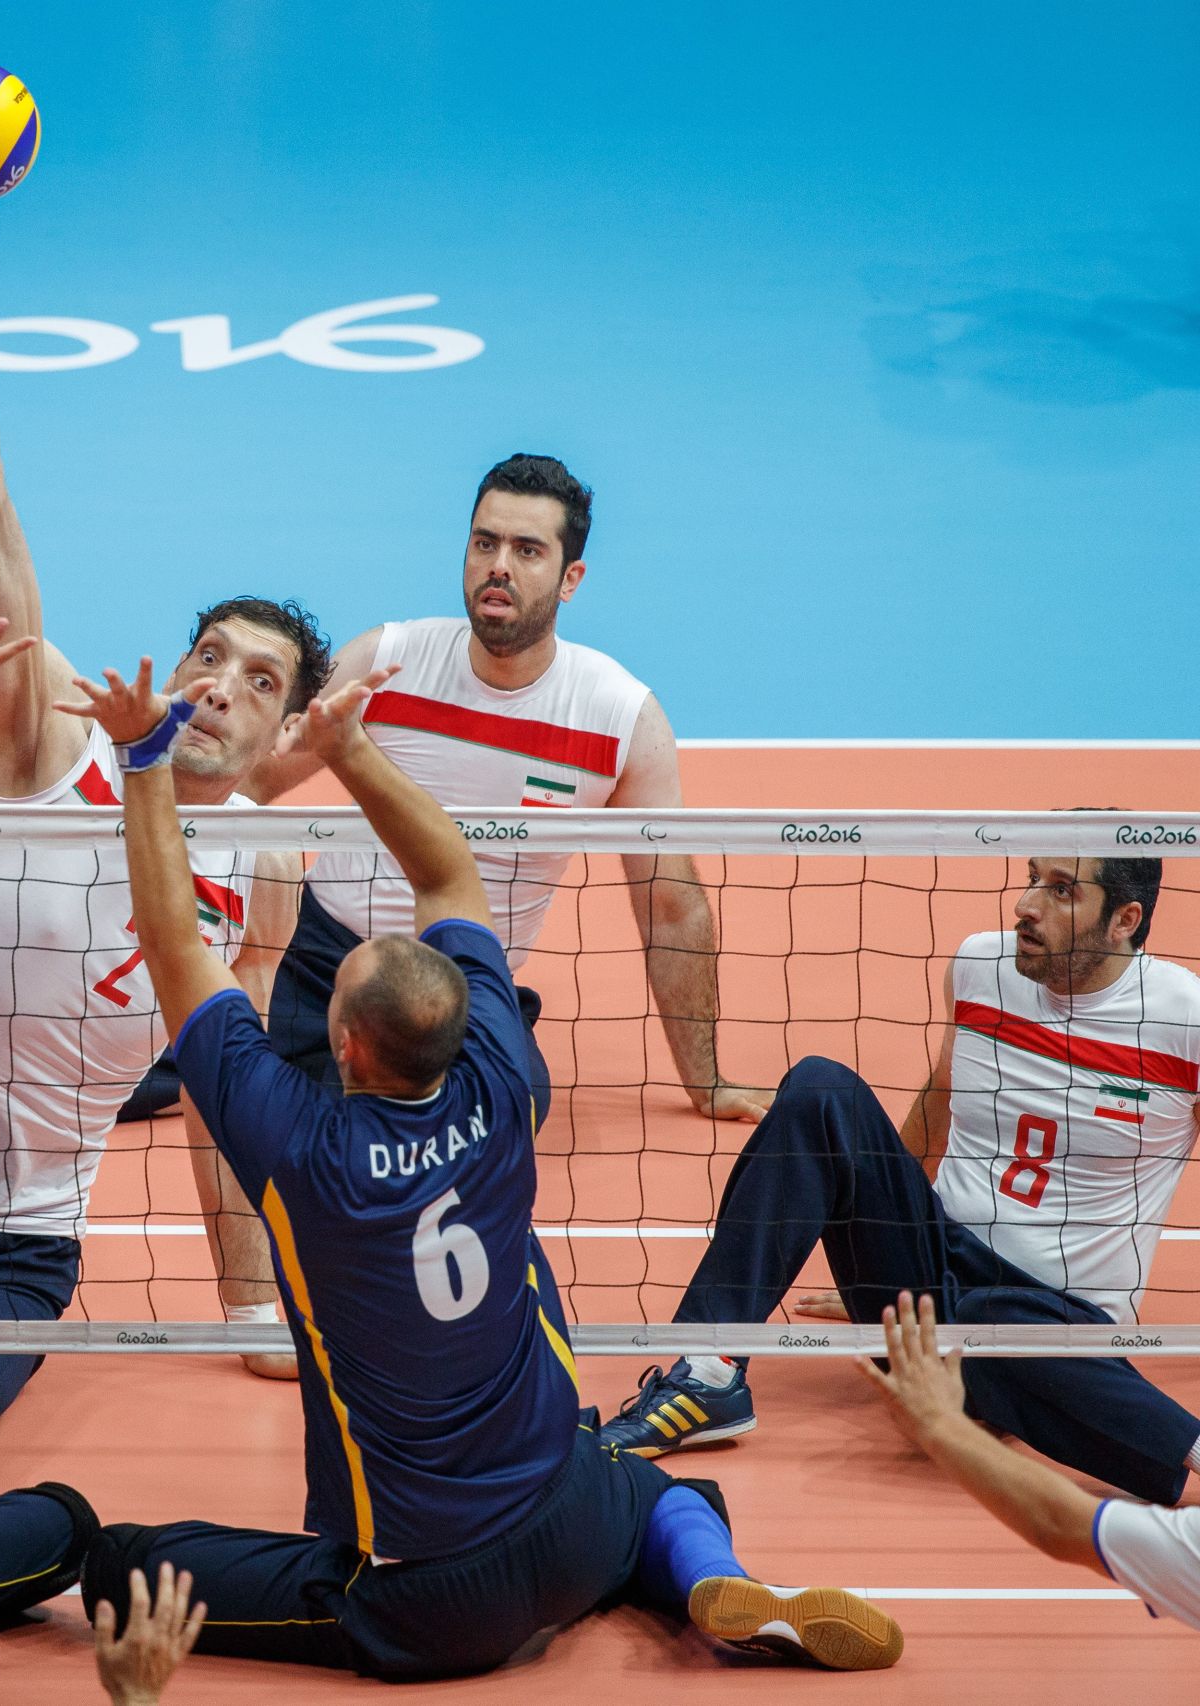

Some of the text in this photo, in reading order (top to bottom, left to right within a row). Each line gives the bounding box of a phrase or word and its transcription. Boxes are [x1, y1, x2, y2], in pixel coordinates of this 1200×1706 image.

[781, 823, 862, 843] Rio2016
[1116, 825, 1197, 845] Rio2016
[369, 1104, 488, 1179] DURAN
[998, 1113, 1059, 1209] 8
[411, 1187, 490, 1322] 6
[117, 1331, 169, 1344] Rio2016
[779, 1335, 830, 1347] Rio2016
[1111, 1335, 1163, 1347] Rio2016
